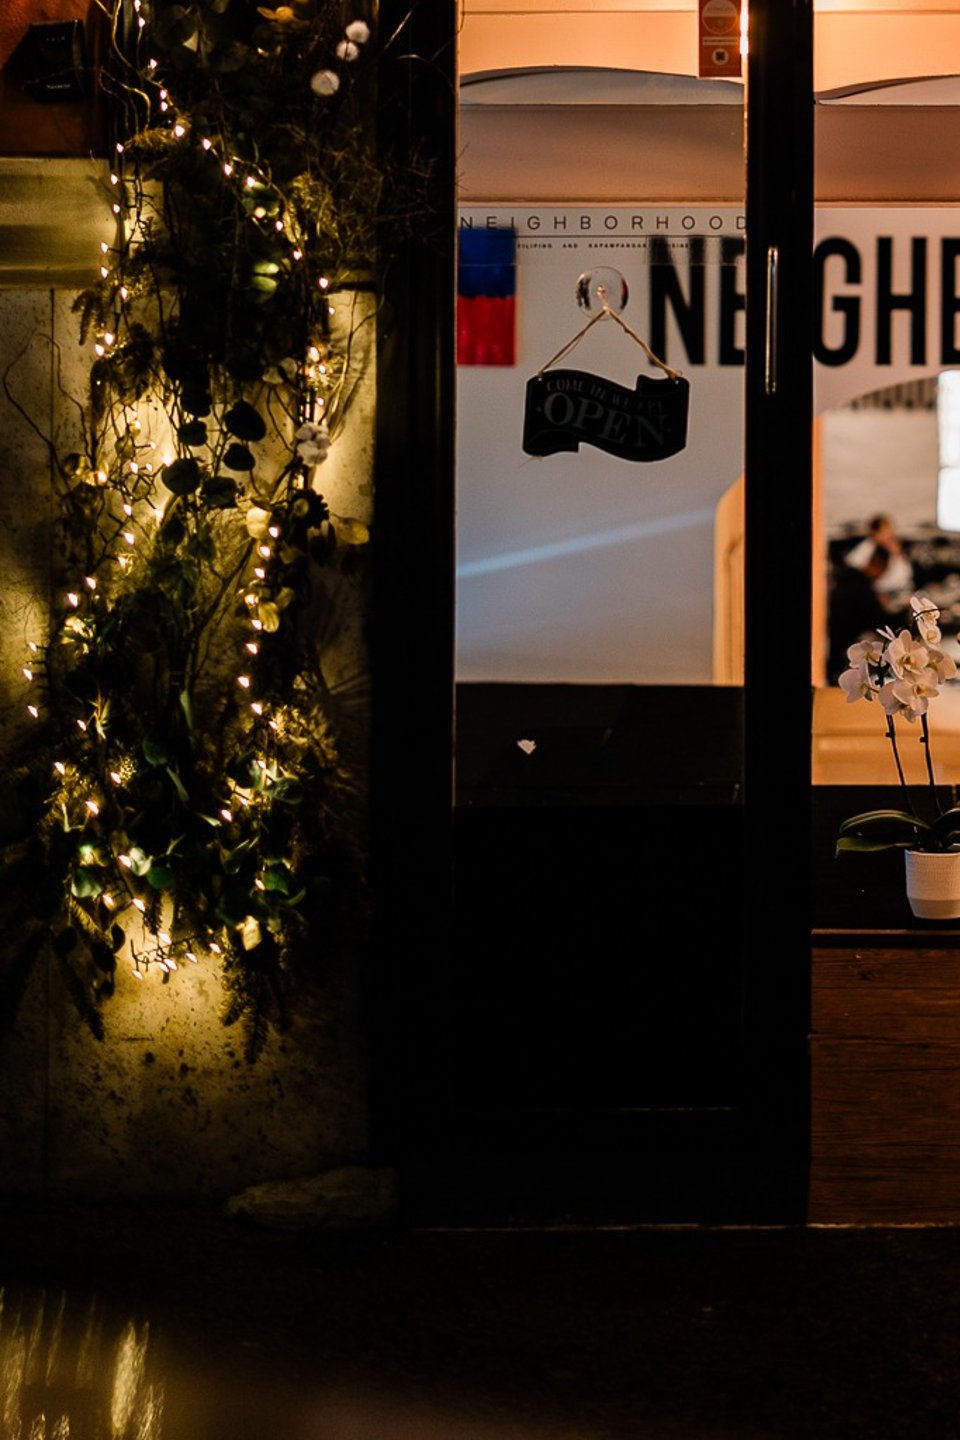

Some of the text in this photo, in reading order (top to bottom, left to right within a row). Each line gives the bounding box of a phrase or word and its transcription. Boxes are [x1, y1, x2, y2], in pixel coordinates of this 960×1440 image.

[460, 215, 747, 231] NEIGHBORHOOD
[546, 378, 585, 393] COME
[543, 391, 669, 448] OPEN
